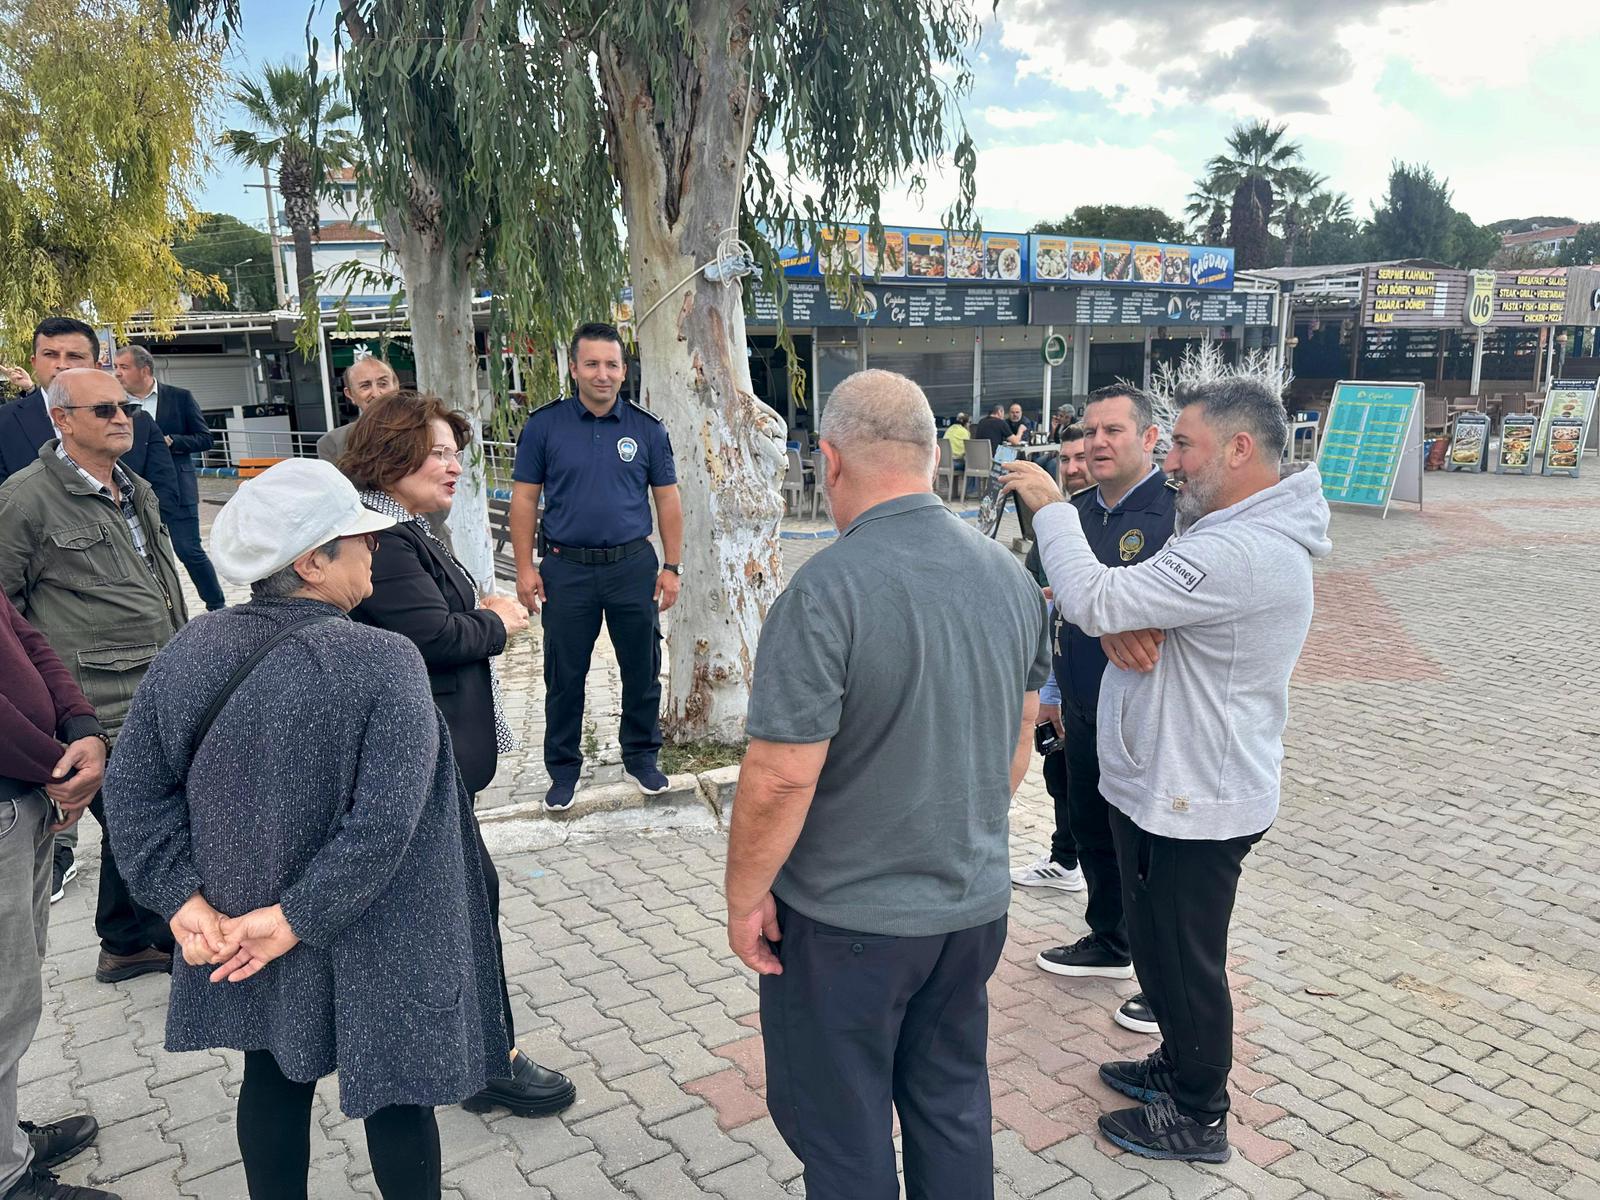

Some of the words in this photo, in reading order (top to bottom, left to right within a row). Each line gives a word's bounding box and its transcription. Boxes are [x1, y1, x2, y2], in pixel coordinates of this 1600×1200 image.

[1192, 253, 1229, 283] ÇAĞDAN
[1405, 270, 1435, 281] KAHVALTI
[1517, 276, 1545, 286] BREAKFAST
[1389, 283, 1411, 296] BÖREK
[1414, 285, 1435, 296] MANTI
[1499, 288, 1516, 298] STEAK
[1404, 298, 1426, 310] DÖNER
[1473, 294, 1490, 318] 06
[1502, 302, 1519, 311] PASTA
